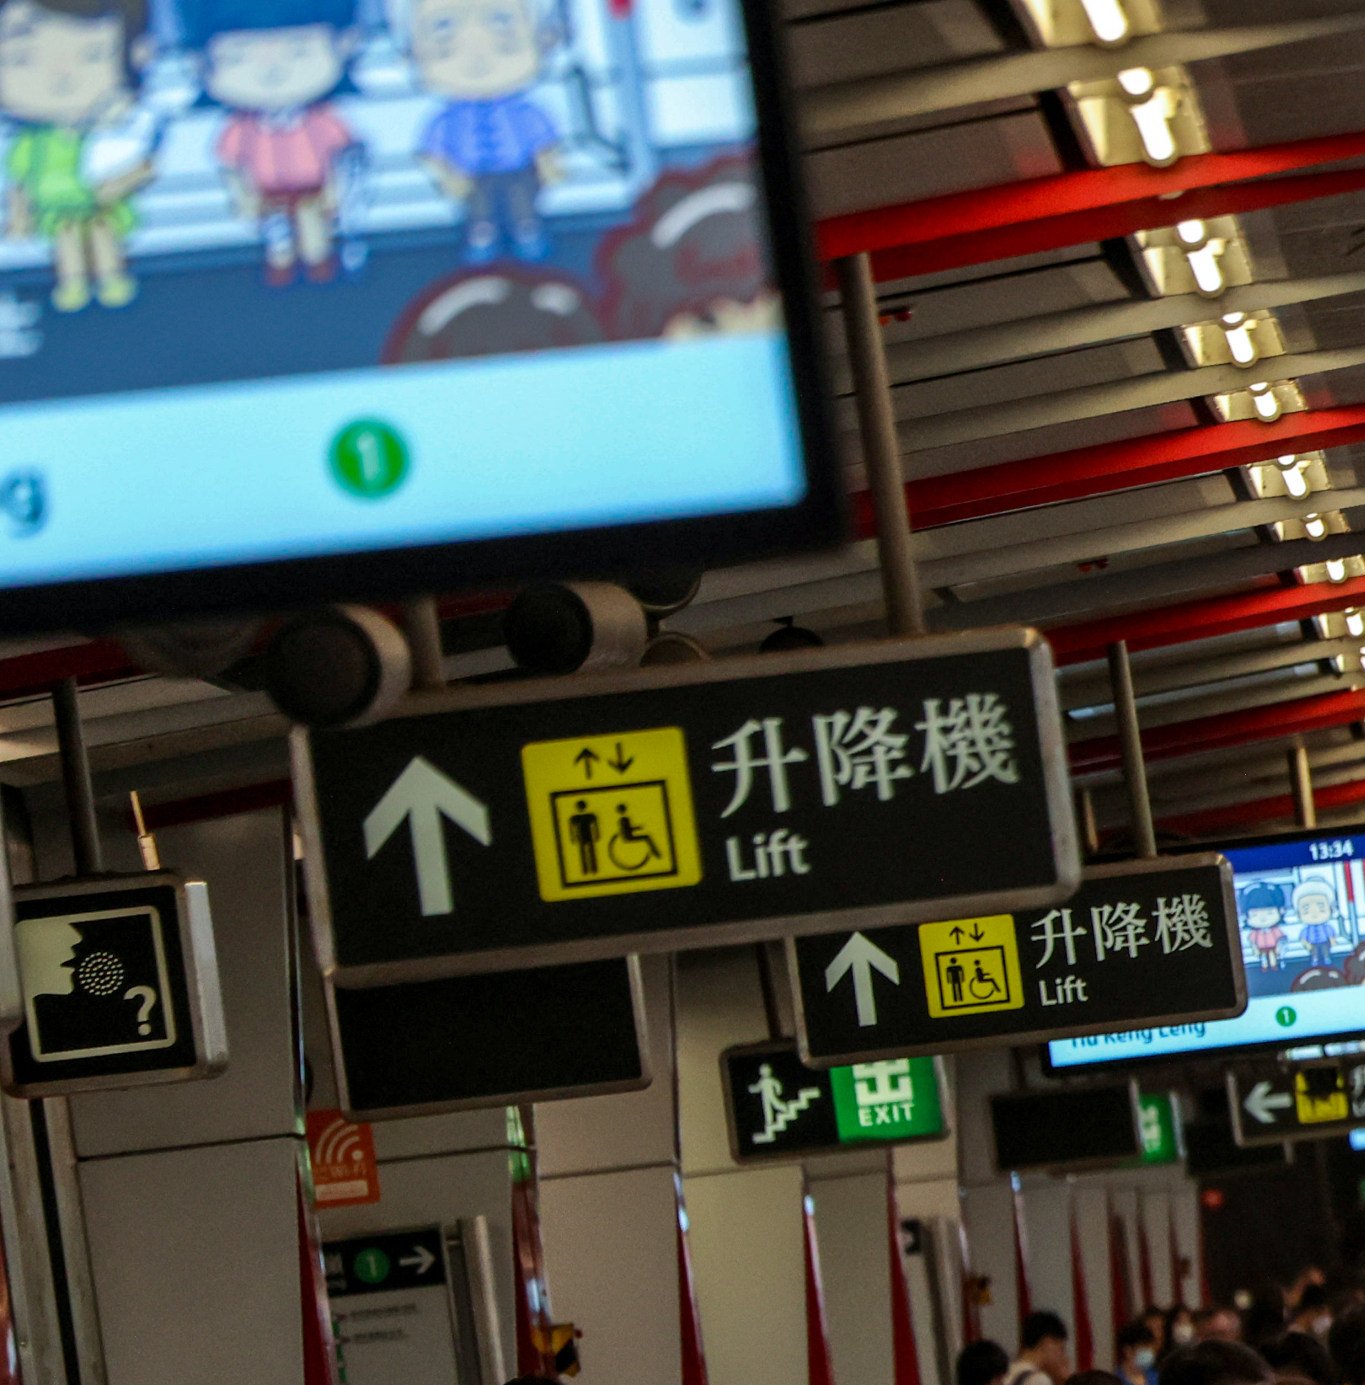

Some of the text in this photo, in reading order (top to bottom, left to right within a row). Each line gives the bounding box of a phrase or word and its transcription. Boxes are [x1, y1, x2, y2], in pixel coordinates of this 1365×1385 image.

[711, 693, 1019, 819] 升降機
[726, 828, 812, 882] Lift
[1308, 840, 1354, 861] 13:34
[1030, 894, 1213, 969] 升降機
[1039, 975, 1089, 1007] Lift
[858, 1102, 915, 1128] EXIT
